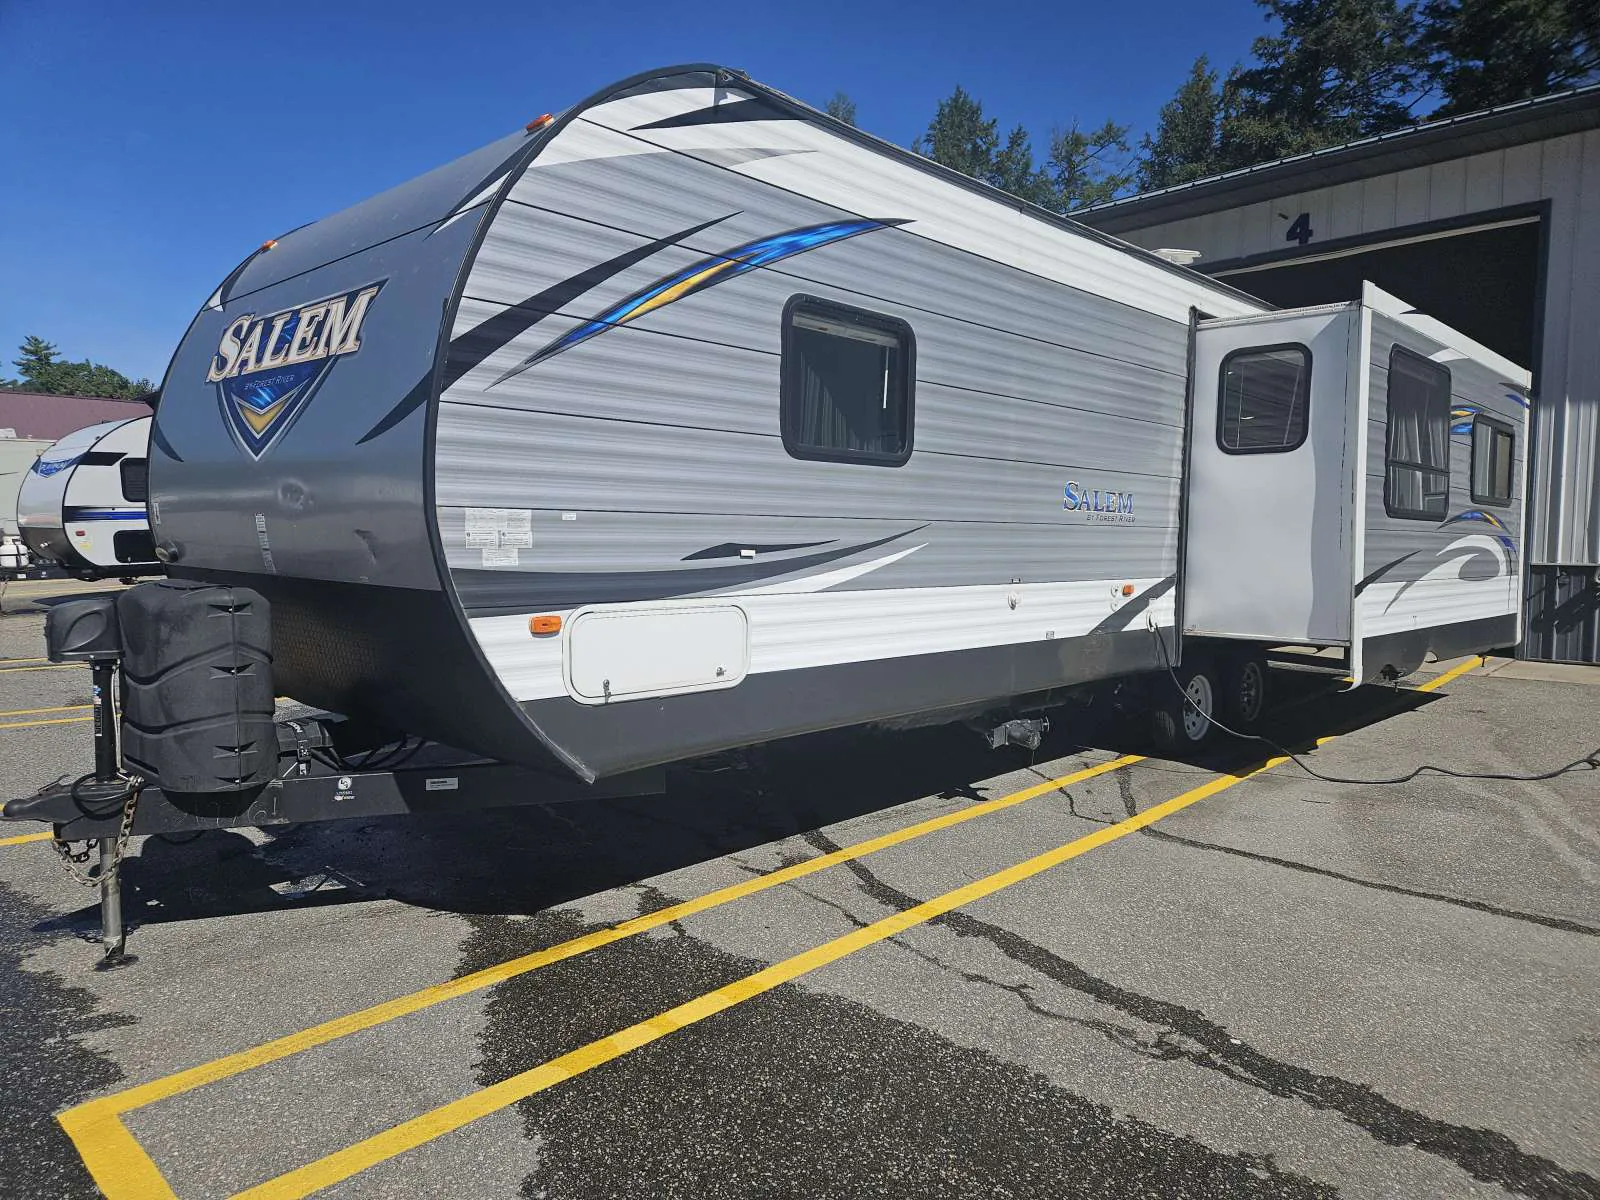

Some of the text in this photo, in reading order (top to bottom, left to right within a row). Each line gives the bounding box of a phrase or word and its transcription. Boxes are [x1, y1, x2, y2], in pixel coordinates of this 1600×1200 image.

[1286, 212, 1313, 245] 4
[206, 285, 379, 383] SALEM
[1062, 480, 1134, 515] SALEM
[1096, 513, 1117, 523] FOREST
[1118, 514, 1136, 523] RIVER
